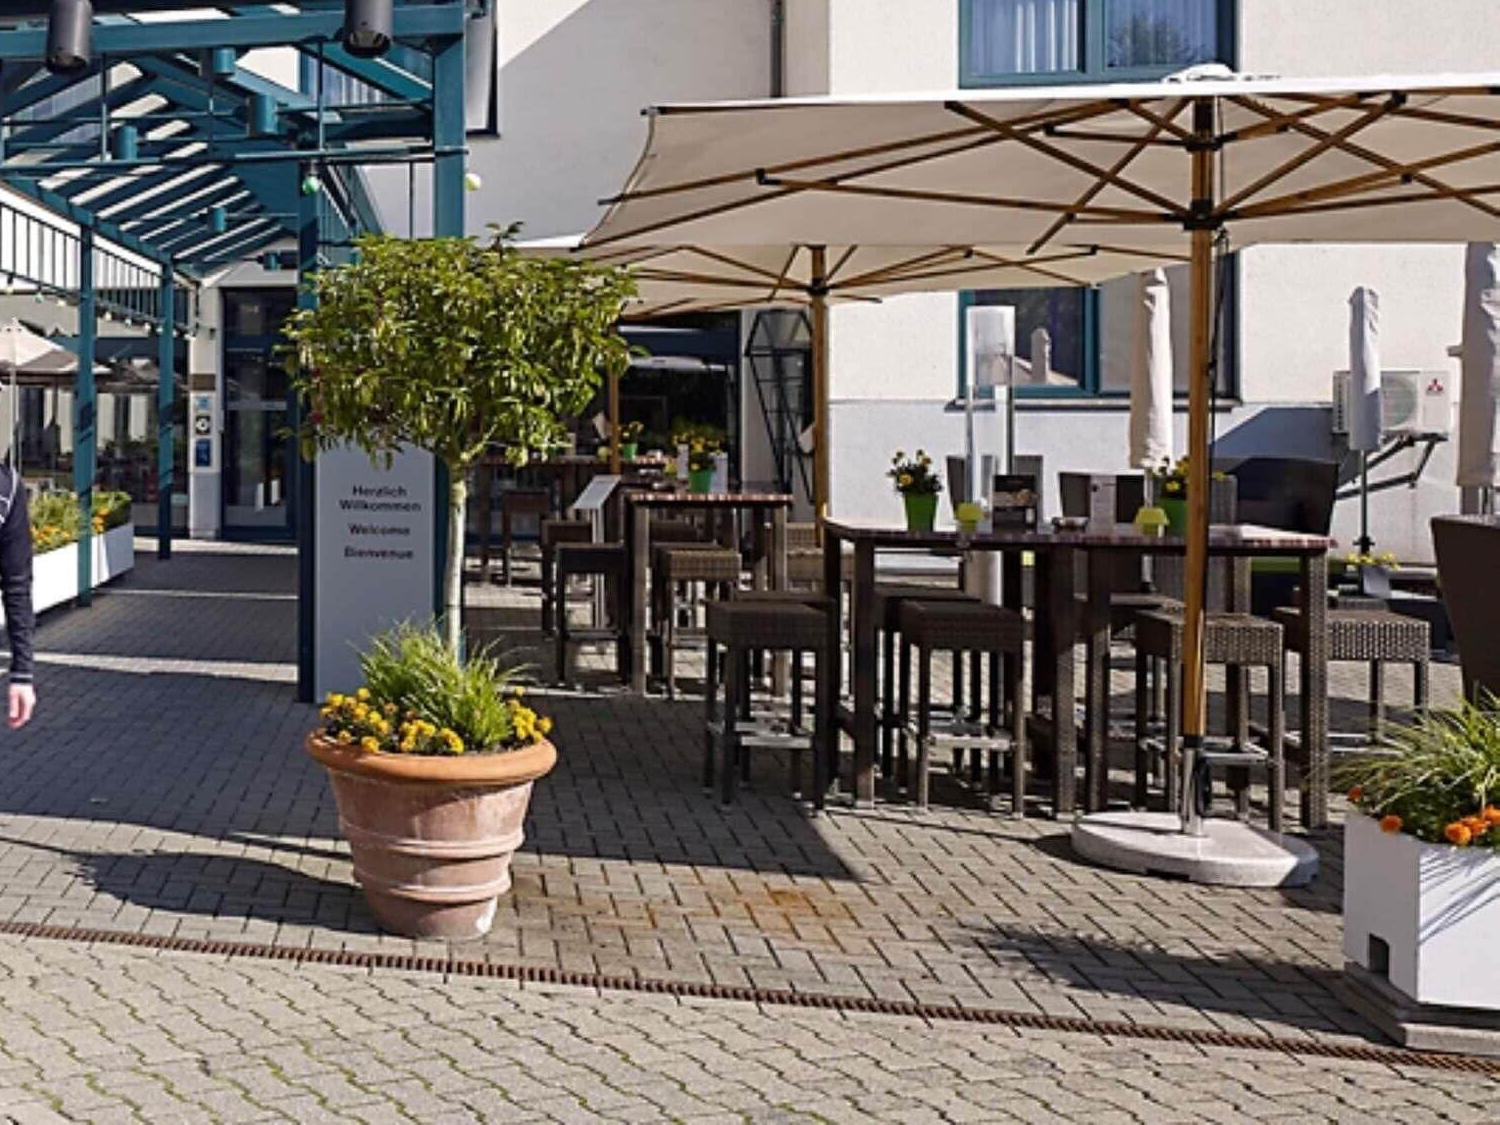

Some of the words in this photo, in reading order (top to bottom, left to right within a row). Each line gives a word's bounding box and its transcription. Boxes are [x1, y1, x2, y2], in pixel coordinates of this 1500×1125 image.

[352, 485, 408, 496] Herzlich
[339, 499, 422, 511] Willkommen
[348, 524, 411, 535] Welcome
[344, 546, 414, 558] Bienvenue
